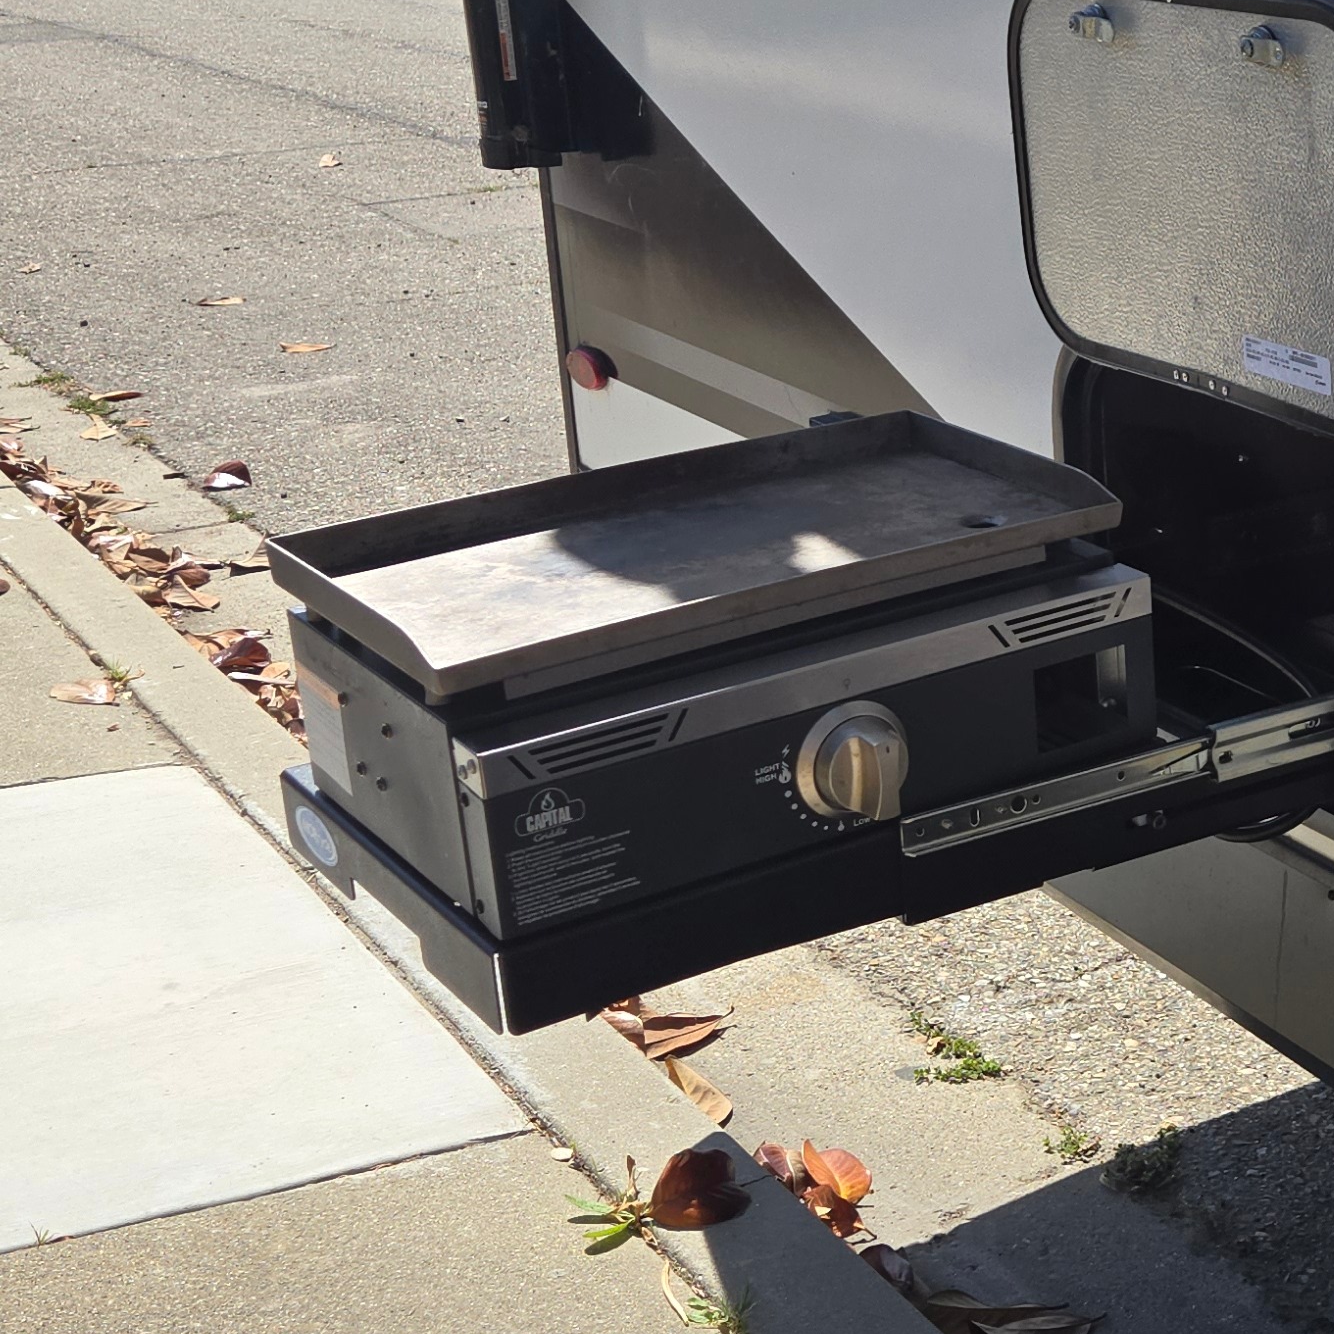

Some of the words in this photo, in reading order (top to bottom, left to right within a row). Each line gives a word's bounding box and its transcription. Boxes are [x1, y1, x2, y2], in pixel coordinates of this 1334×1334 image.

[754, 762, 781, 776] LIGHT
[755, 773, 778, 785] HIGH
[526, 805, 574, 833] CAPITAL
